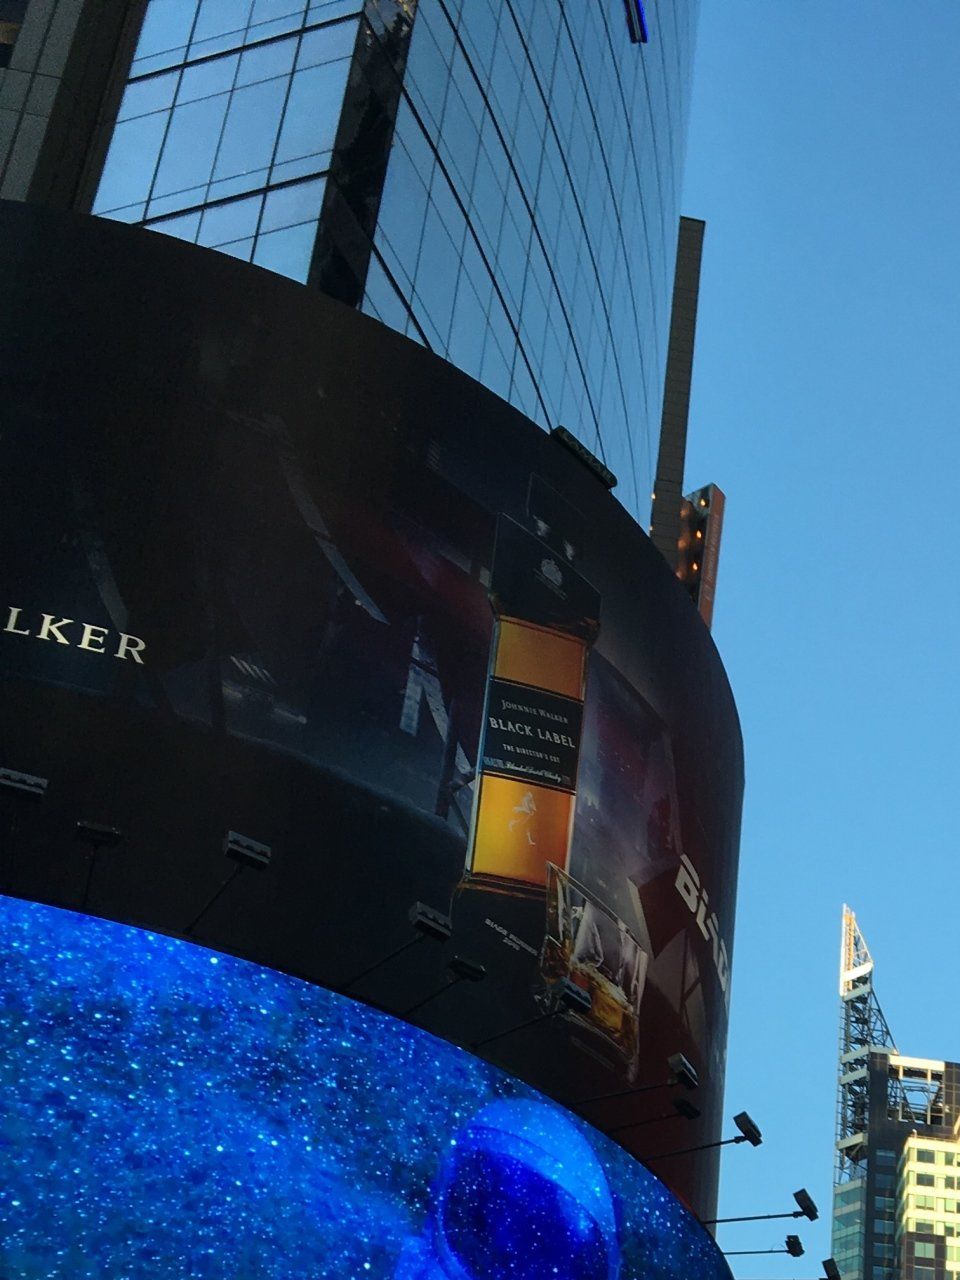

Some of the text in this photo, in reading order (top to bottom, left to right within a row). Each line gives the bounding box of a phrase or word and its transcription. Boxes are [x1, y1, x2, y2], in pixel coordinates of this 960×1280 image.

[3, 605, 146, 665] LKER
[489, 717, 576, 748] BLACK LABEL
